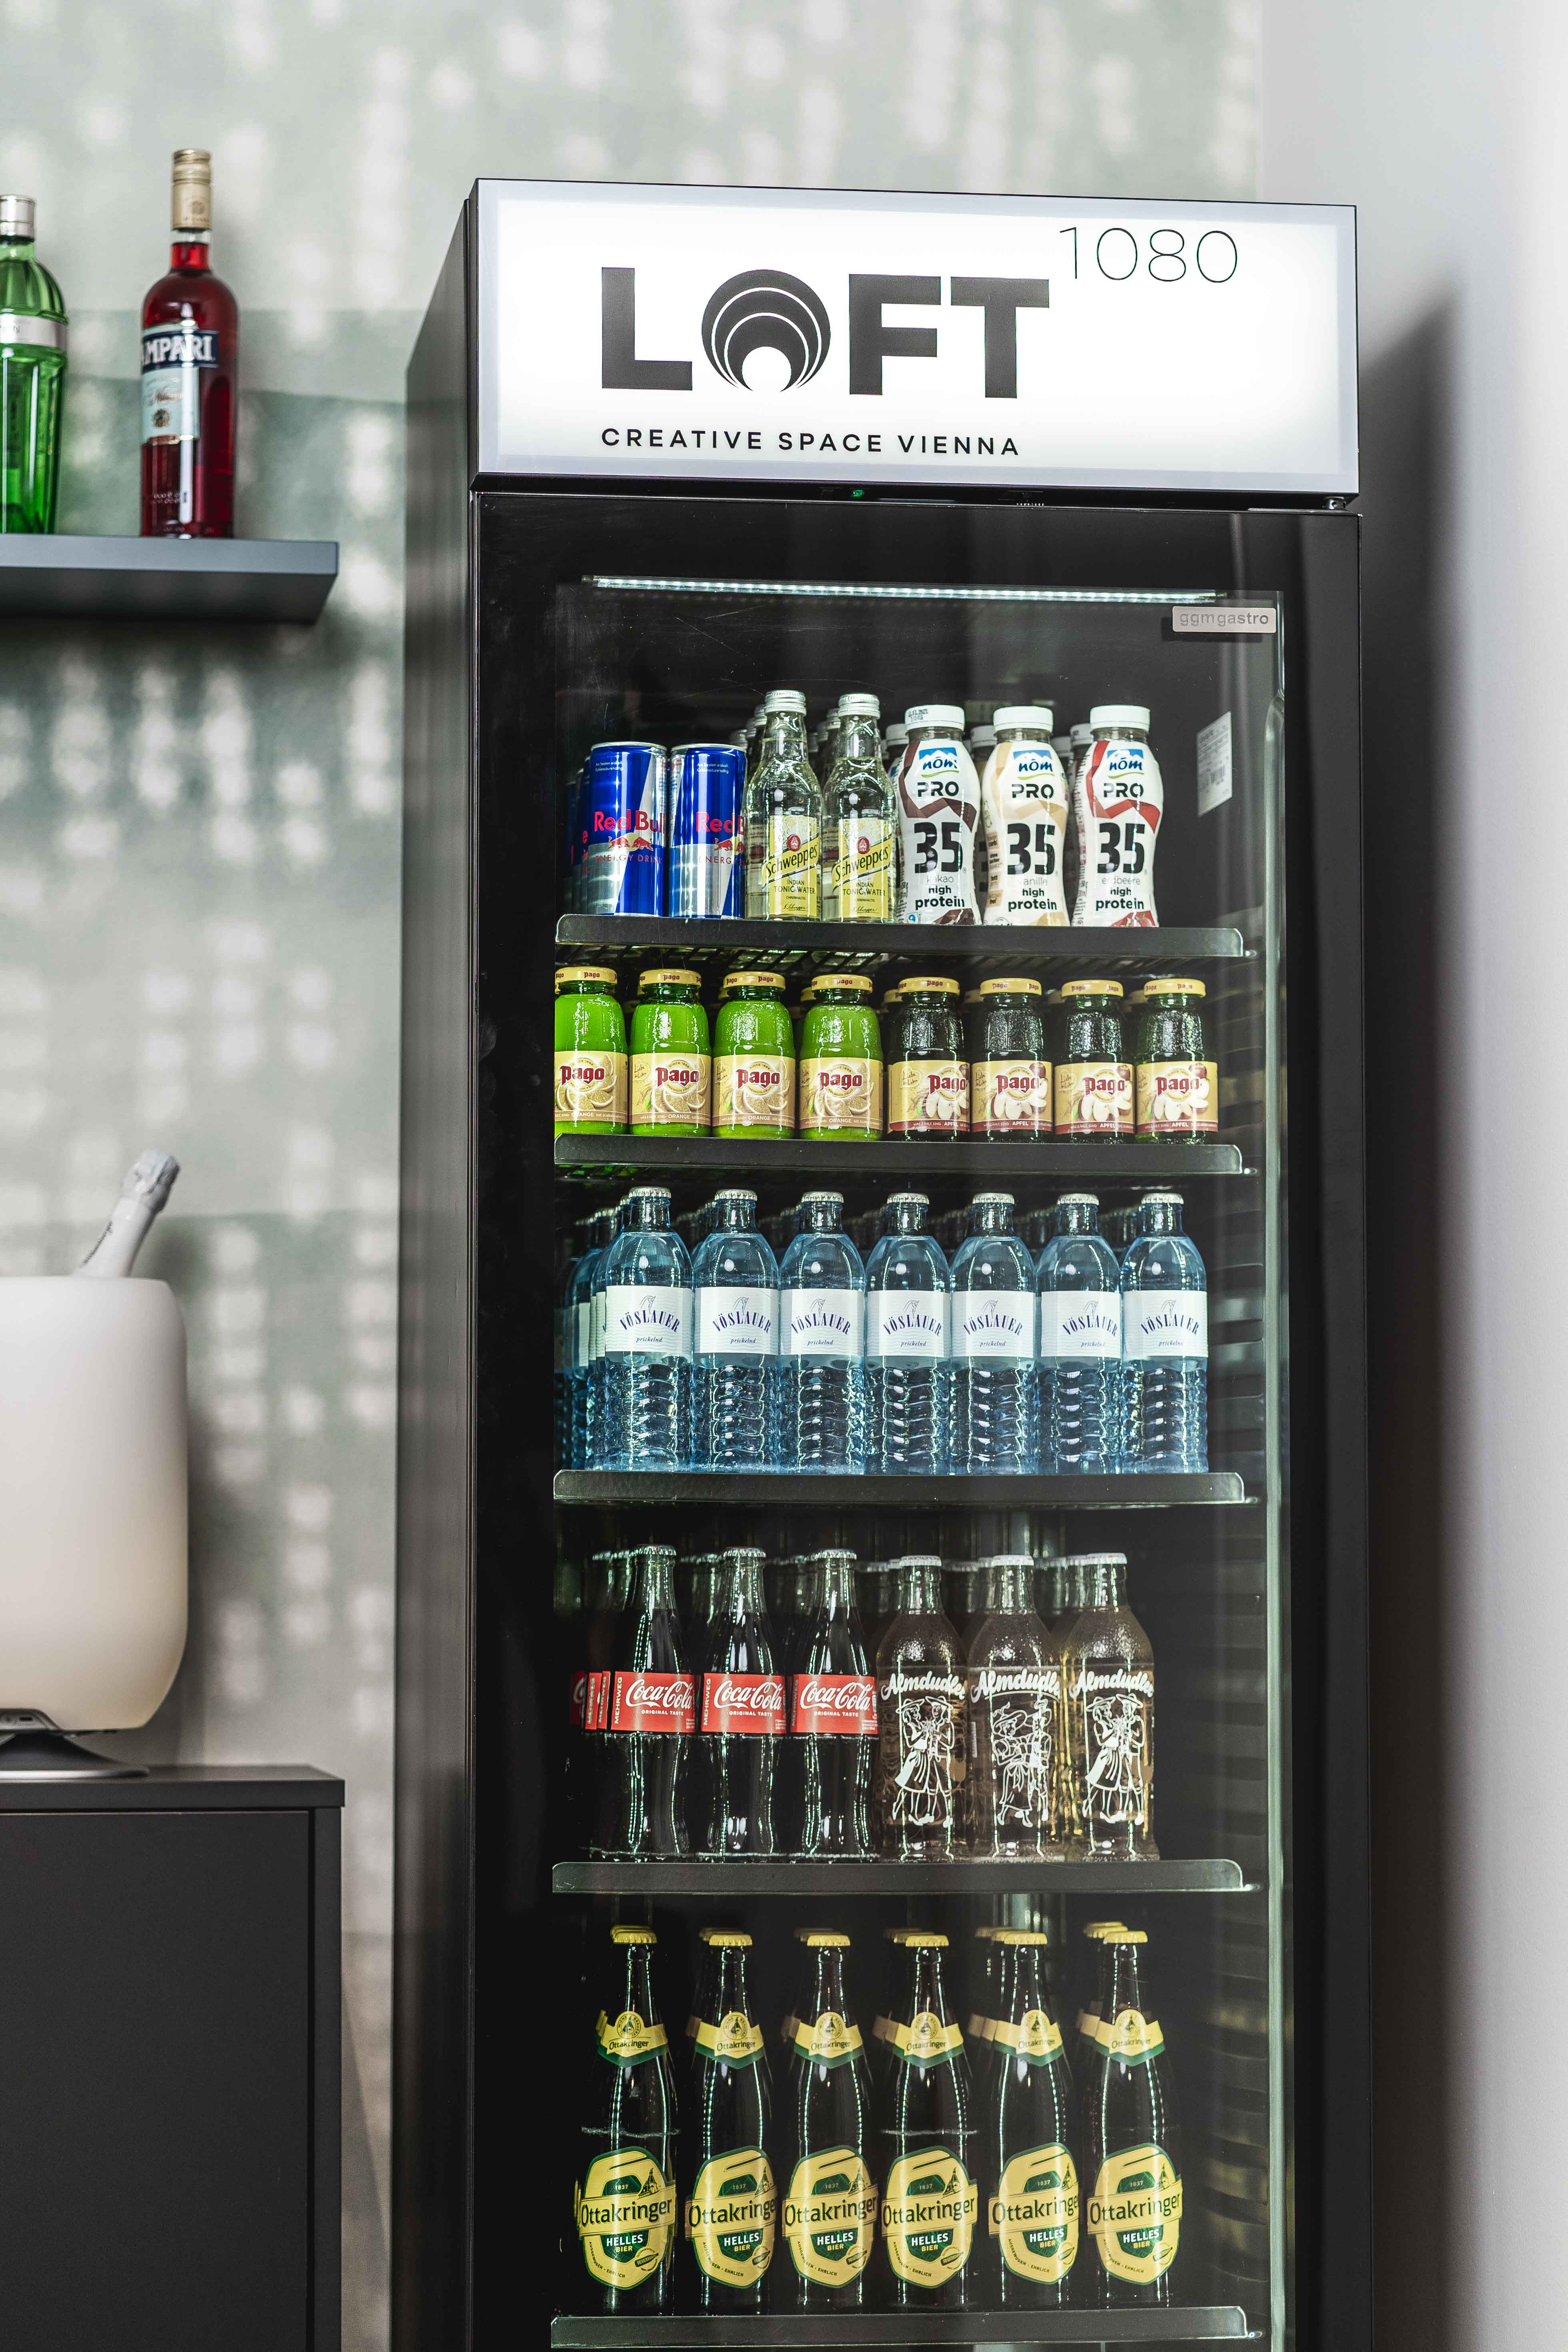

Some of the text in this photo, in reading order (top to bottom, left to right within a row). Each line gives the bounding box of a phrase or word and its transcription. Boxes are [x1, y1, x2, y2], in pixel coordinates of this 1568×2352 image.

[1059, 226, 1239, 283] 1080
[602, 267, 1050, 399] LOFT
[601, 428, 1019, 455] CREATIVE SPACE VIENNA
[1179, 611, 1269, 627] ggmgastro
[917, 781, 959, 797] PRO
[1012, 783, 1054, 799] PRO
[1104, 783, 1144, 798] PRO
[594, 809, 665, 834] Red Bull
[696, 811, 735, 833] Red
[914, 822, 963, 873] 35
[1007, 823, 1055, 875] 35
[1097, 823, 1146, 874] 35
[595, 854, 662, 864] ENERGY DRINK
[765, 845, 818, 878] Schweppes
[835, 846, 889, 882] Schweppes
[1018, 877, 1048, 886] anille
[1102, 876, 1141, 885] ebeere
[797, 886, 815, 894] WATER
[865, 888, 886, 897] WATER
[928, 885, 952, 895] high
[1022, 888, 1045, 897] high
[1110, 887, 1132, 897] high
[915, 896, 965, 911] protein
[1008, 899, 1057, 912] protein
[1096, 898, 1144, 911] protein
[619, 1310, 680, 1333] VÖSLAUER
[712, 1311, 771, 1334] VÖSLAUER
[791, 1312, 851, 1336] VÖSLAUER
[883, 1314, 942, 1337] VÖSLAUER
[963, 1314, 1023, 1336] VÖSLAUER
[1062, 1314, 1118, 1337] VÖSLAUER
[636, 1335, 663, 1344] prickelnd
[881, 1670, 965, 1700] Almdudler
[1069, 1668, 1154, 1698] Almdudler
[614, 1676, 623, 1724] MEHRWEG
[625, 1679, 693, 1709] Coca-Cola
[703, 1678, 711, 1726] MEHRWEG
[713, 1680, 783, 1711] Coca-Cola
[800, 1680, 874, 1711] Coca-Cola
[609, 2040, 650, 2050] Ottakringer
[717, 2041, 755, 2051] Ottakringer
[811, 2041, 851, 2051] Ottakringer
[906, 2041, 947, 2051] Ottakringer
[581, 2198, 672, 2228] Ottakringer
[689, 2199, 775, 2228] Ottakringe
[784, 2195, 878, 2227] Ottakringer
[883, 2197, 974, 2228] Ottakringer
[992, 2194, 1079, 2225] Ottakringe
[1090, 2193, 1180, 2225] Ottakringer
[606, 2234, 644, 2247] HELLES
[724, 2232, 760, 2246] HELLES
[817, 2232, 854, 2246] HELLES
[911, 2232, 949, 2246] HELLES
[1029, 2228, 1064, 2243] HELLES
[1123, 2228, 1160, 2243] HELLES
[827, 2243, 844, 2252] BIER
[921, 2243, 938, 2252] BIER
[1039, 2240, 1056, 2248] BIER
[1133, 2240, 1151, 2248] BIER
[589, 2241, 626, 2278] AUSGEWOGEN EHRLICH
[703, 2242, 744, 2277] AUSGEWOGEN EHRLICH
[818, 2267, 837, 2276] EHRLICH
[1031, 2264, 1050, 2273] EHRLICH
